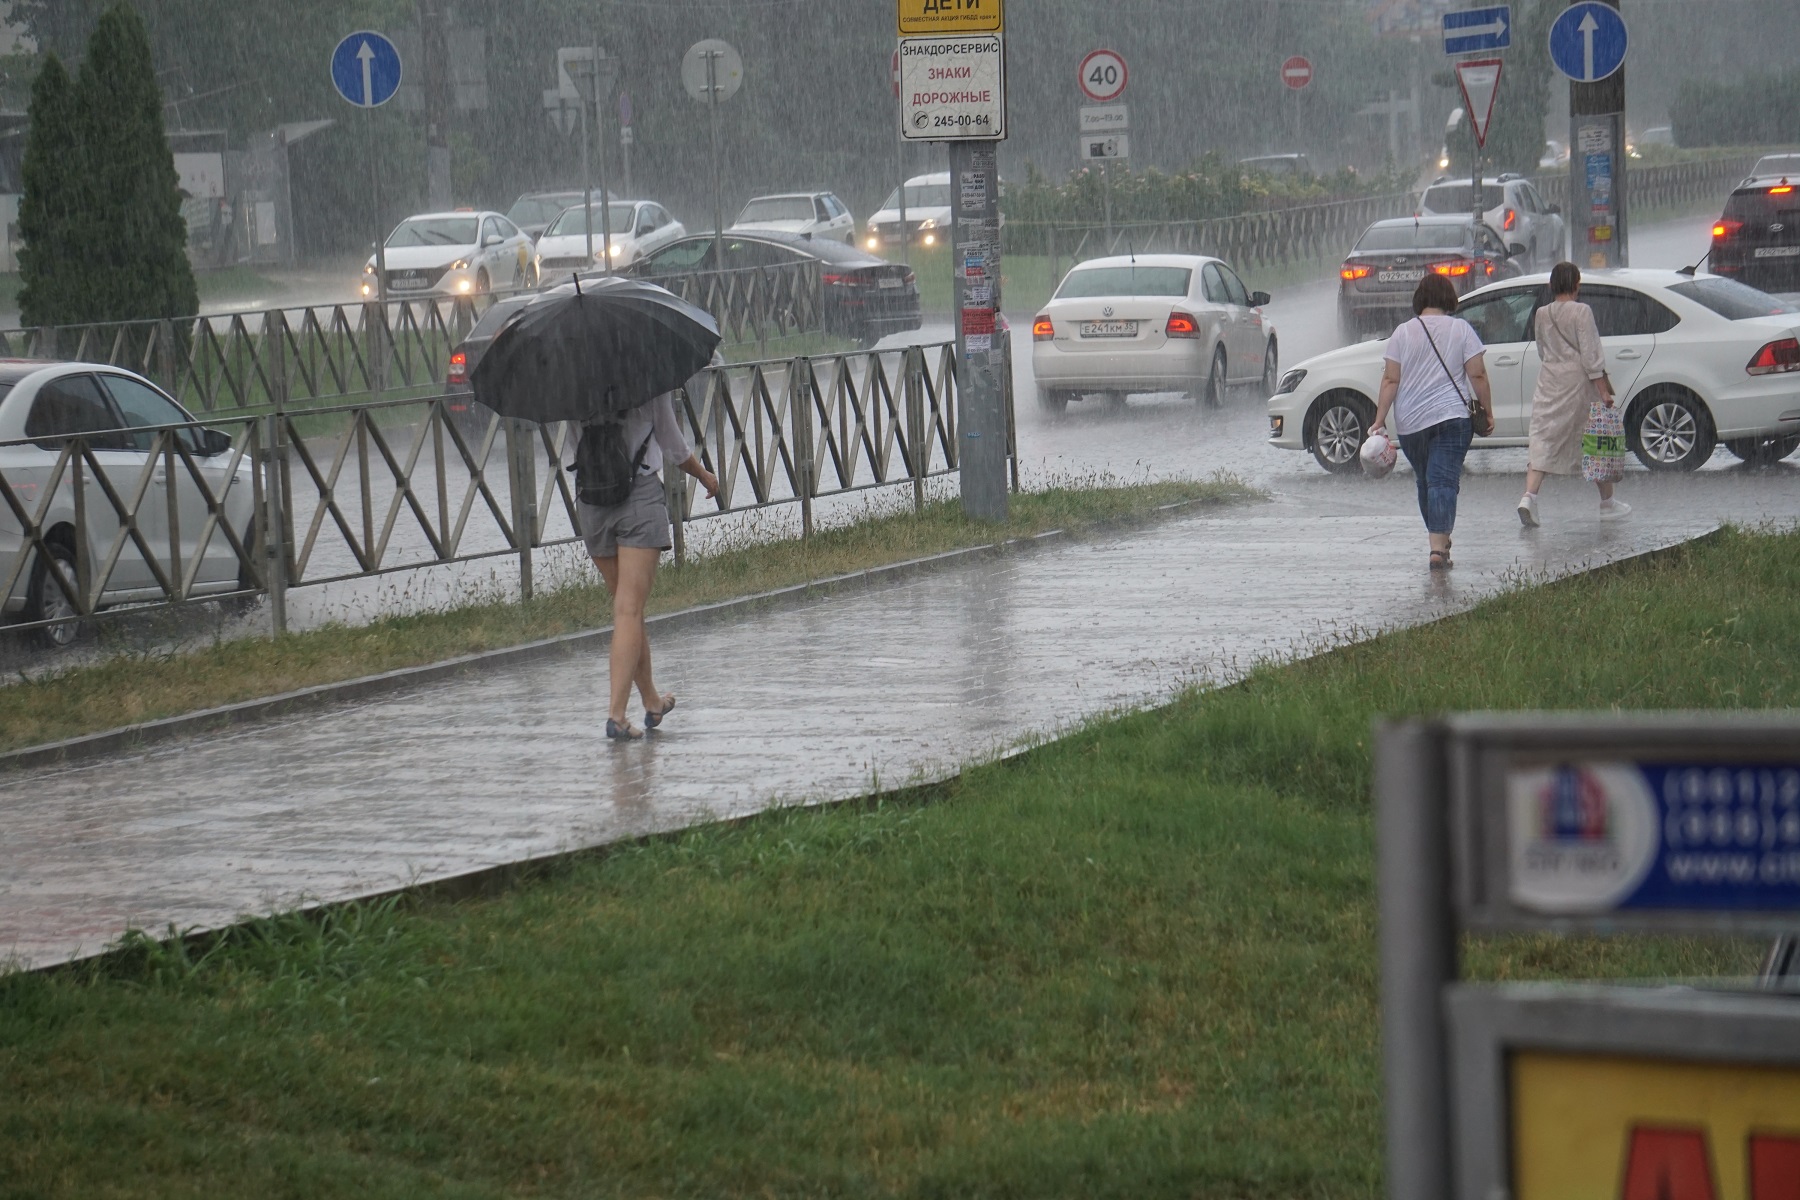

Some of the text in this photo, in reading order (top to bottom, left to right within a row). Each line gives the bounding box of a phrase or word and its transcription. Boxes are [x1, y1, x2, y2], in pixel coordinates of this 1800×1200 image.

[902, 42, 998, 56] ЗНАКДОРСЕРВИС
[928, 66, 971, 80] ЗНАКИ
[1089, 65, 1117, 85] 40
[912, 90, 991, 106] ДОРОЖНЫЕ
[934, 114, 989, 127] 245-00-64
[1597, 436, 1618, 451] FIX
